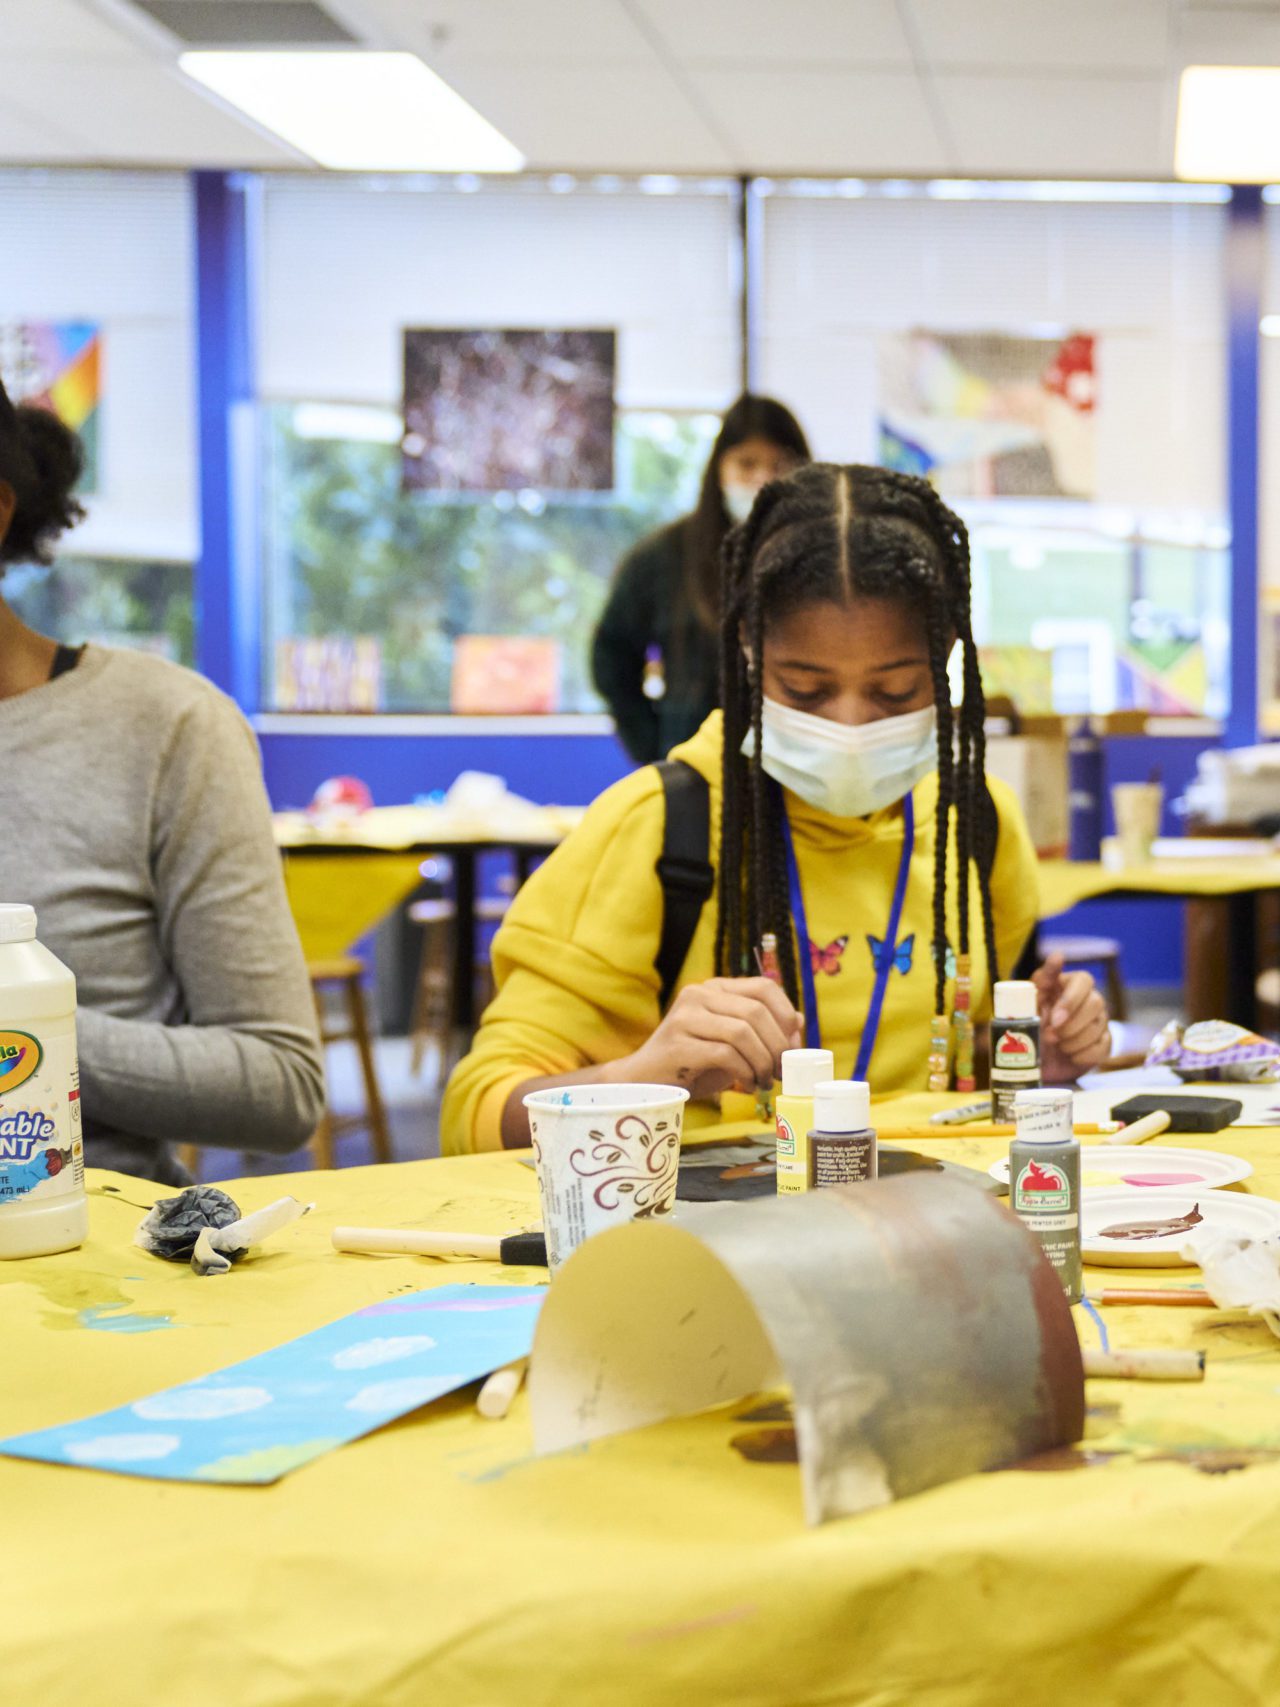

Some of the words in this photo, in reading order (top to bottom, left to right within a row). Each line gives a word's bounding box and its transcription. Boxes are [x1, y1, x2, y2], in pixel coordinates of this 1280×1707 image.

[0, 1114, 53, 1138] able
[0, 1186, 14, 1194] 473
[1045, 1251, 1066, 1259] YING
